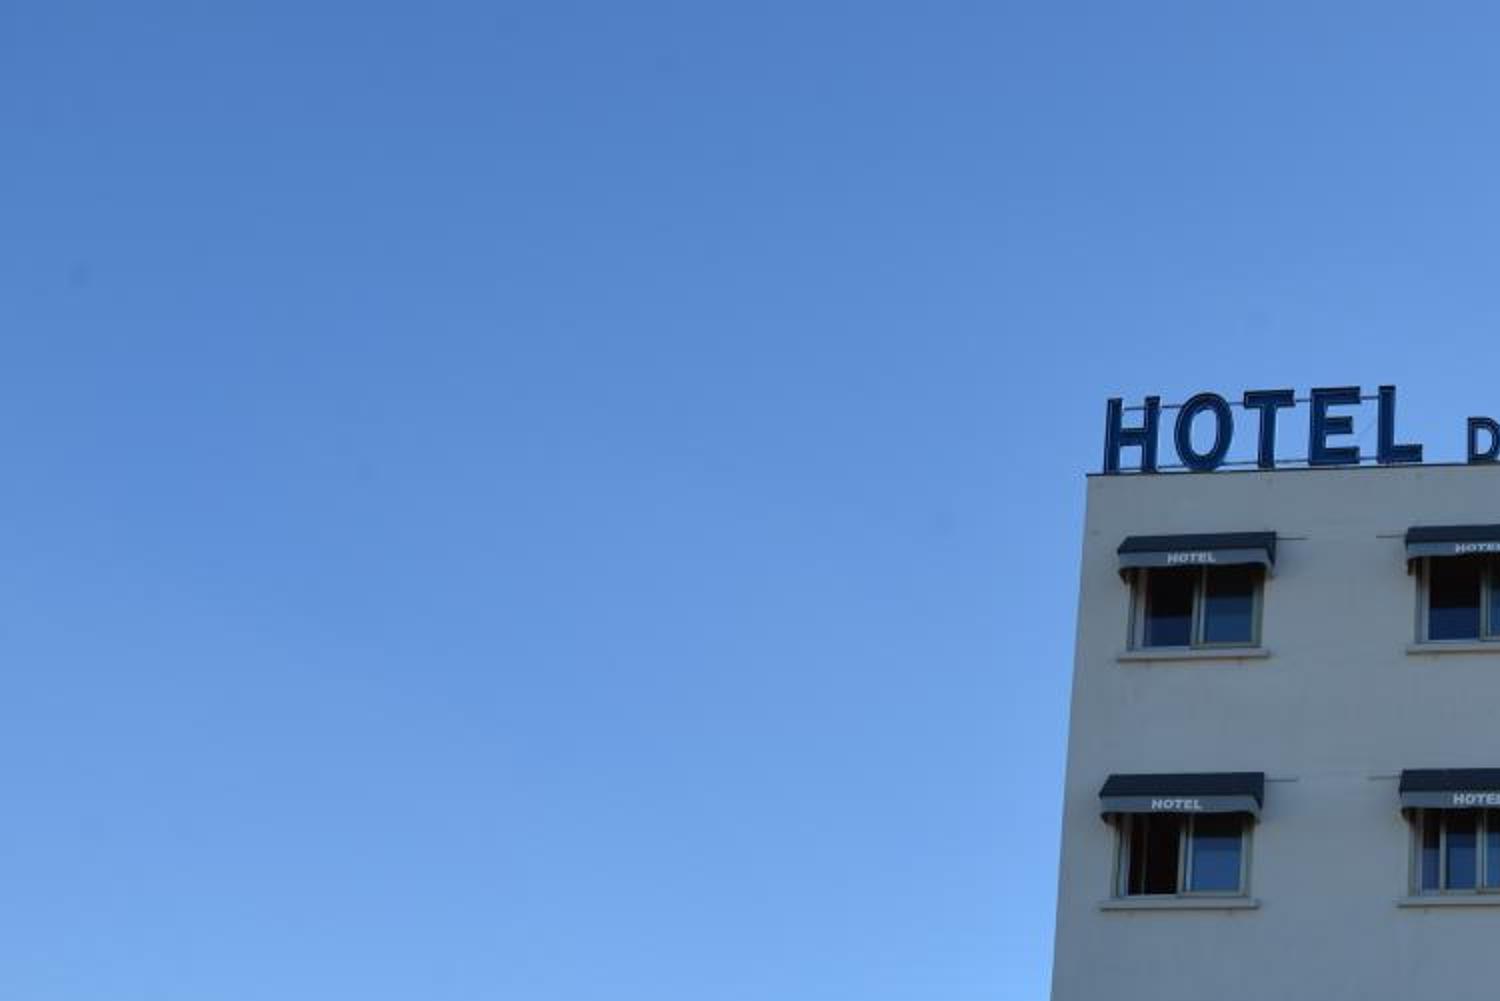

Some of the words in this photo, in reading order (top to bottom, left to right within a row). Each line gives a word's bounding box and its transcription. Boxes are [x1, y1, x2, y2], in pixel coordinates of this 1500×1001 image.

[1103, 385, 1422, 474] HOTEL
[1167, 551, 1217, 565] HOTEL
[1151, 799, 1203, 810] HOTEL
